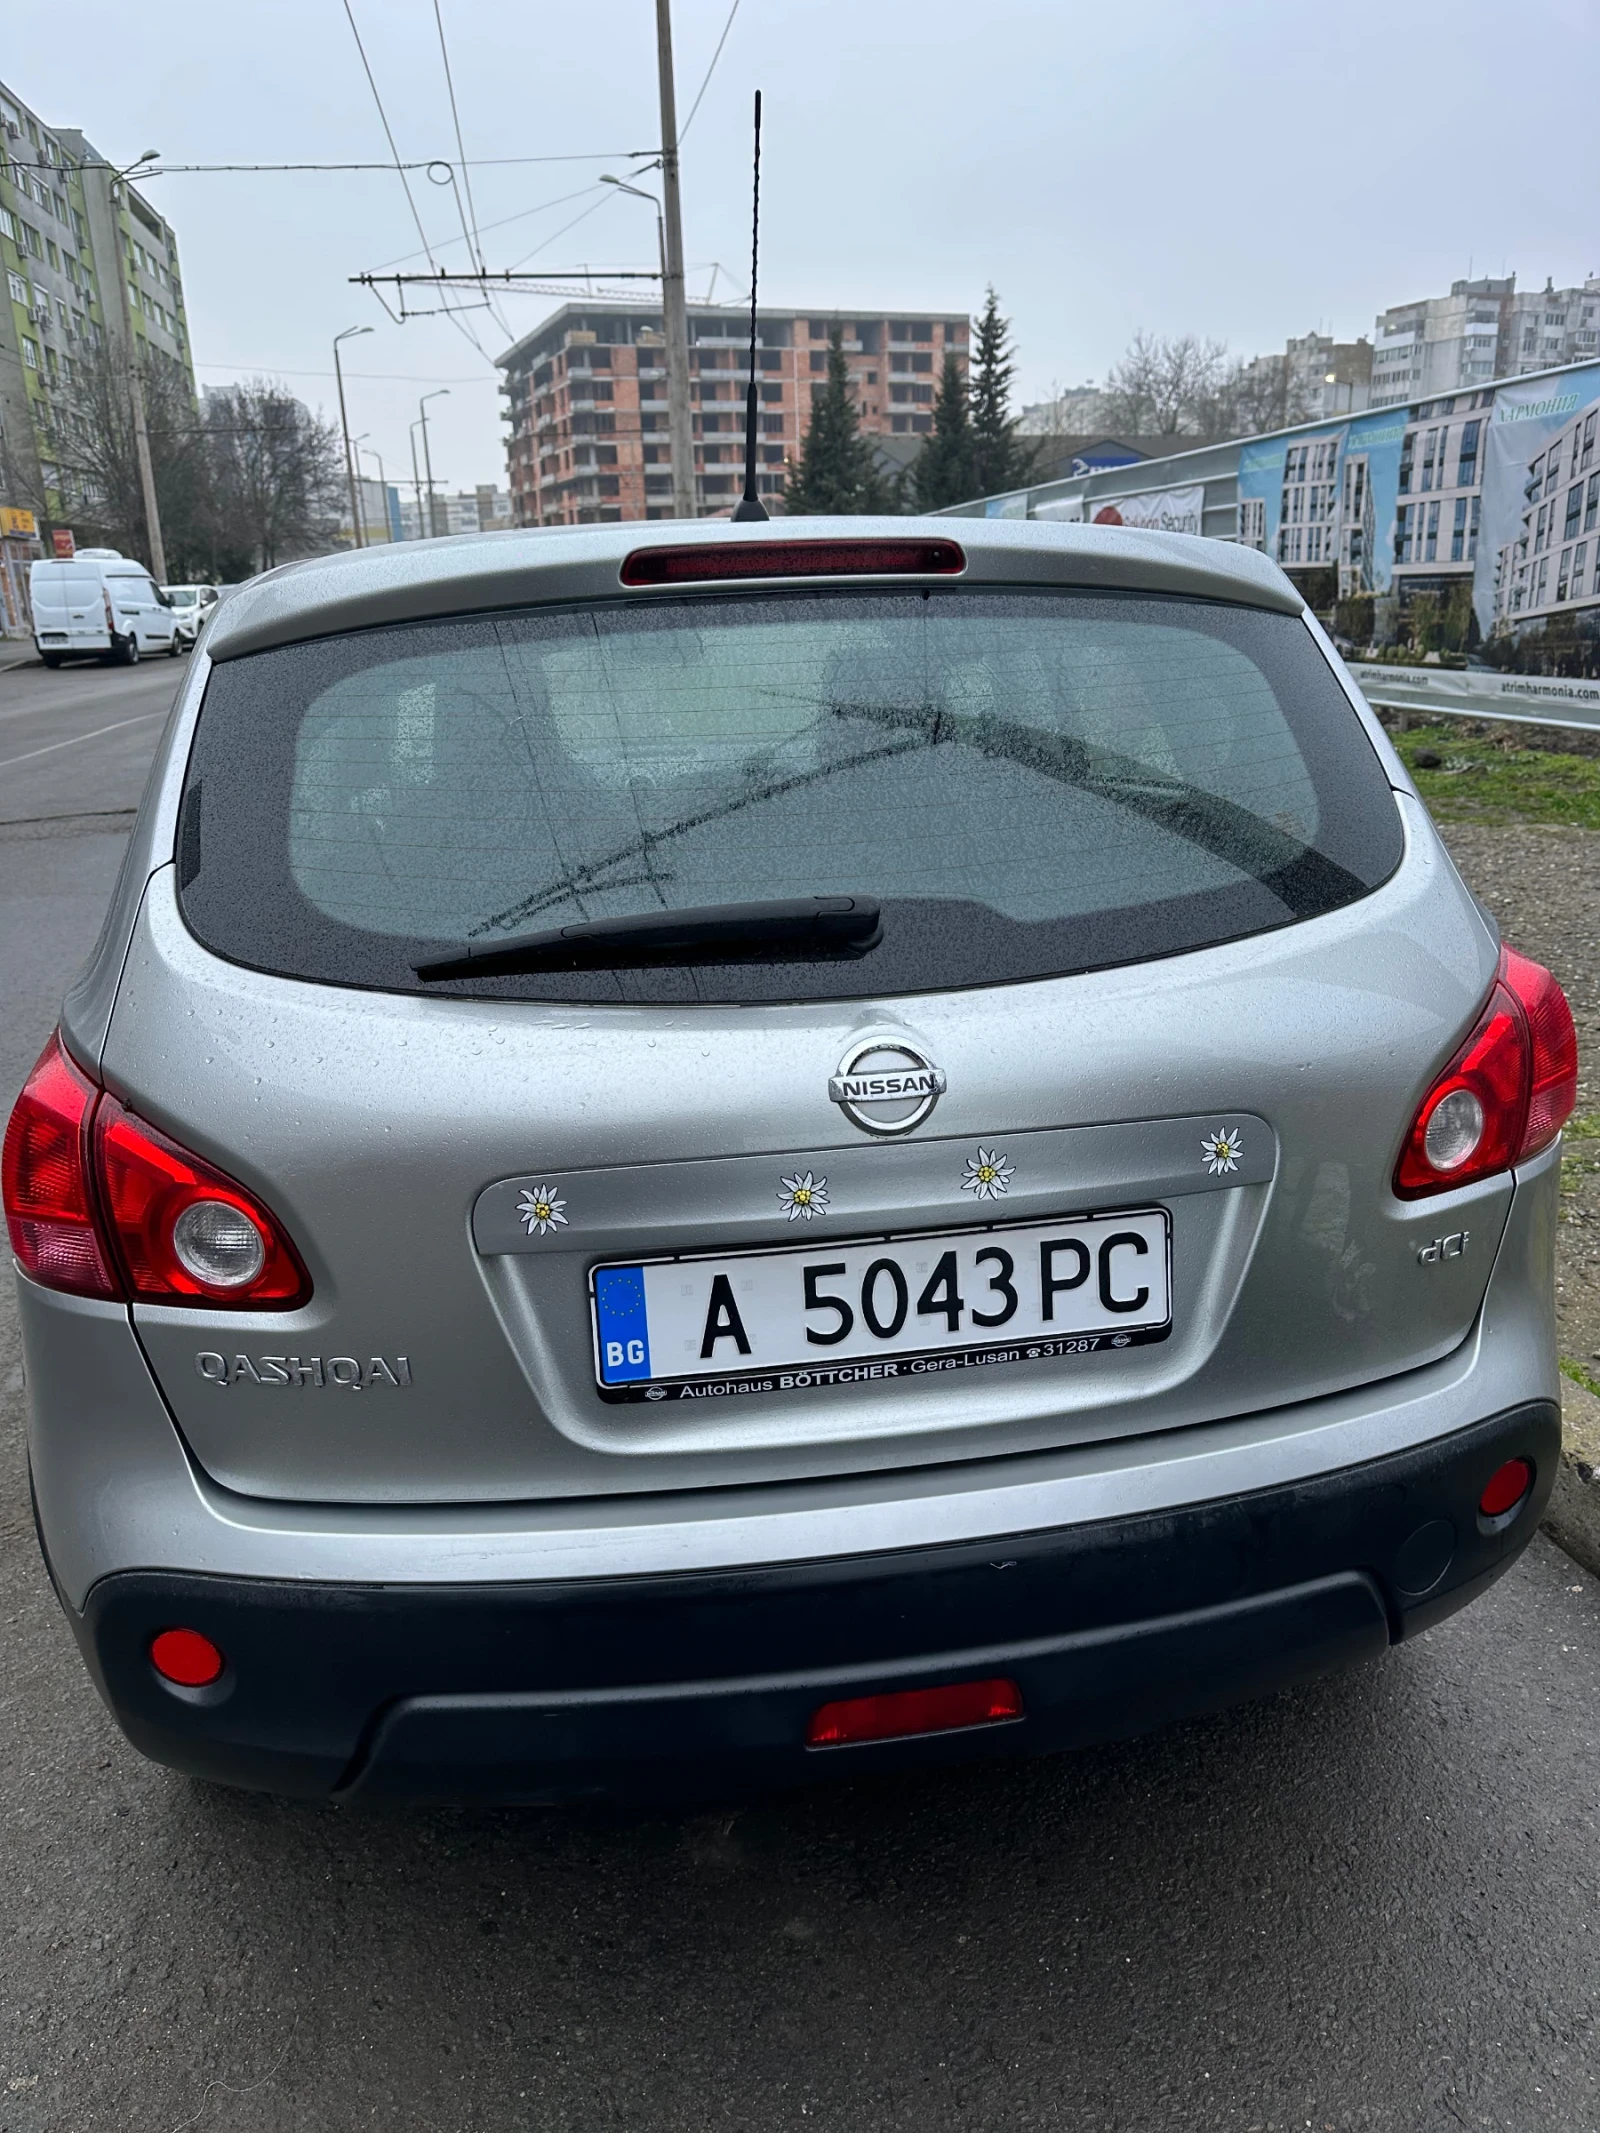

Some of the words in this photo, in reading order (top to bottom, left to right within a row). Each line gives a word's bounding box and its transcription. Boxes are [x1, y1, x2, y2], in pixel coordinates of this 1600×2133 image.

[1360, 669, 1429, 685] atrimharmonia.com
[1501, 681, 1600, 701] atrimharmonia.com
[842, 1072, 936, 1097] NISSAN
[699, 1273, 753, 1360] A
[802, 1245, 1019, 1346] 5043
[606, 1340, 645, 1368] BG
[680, 1380, 773, 1398] Autohaus
[779, 1363, 899, 1389] BÖTTCHER
[911, 1350, 1020, 1374] Gera-Lusan
[1043, 1338, 1101, 1357] 31287
[195, 1351, 413, 1391] QASHQAI
